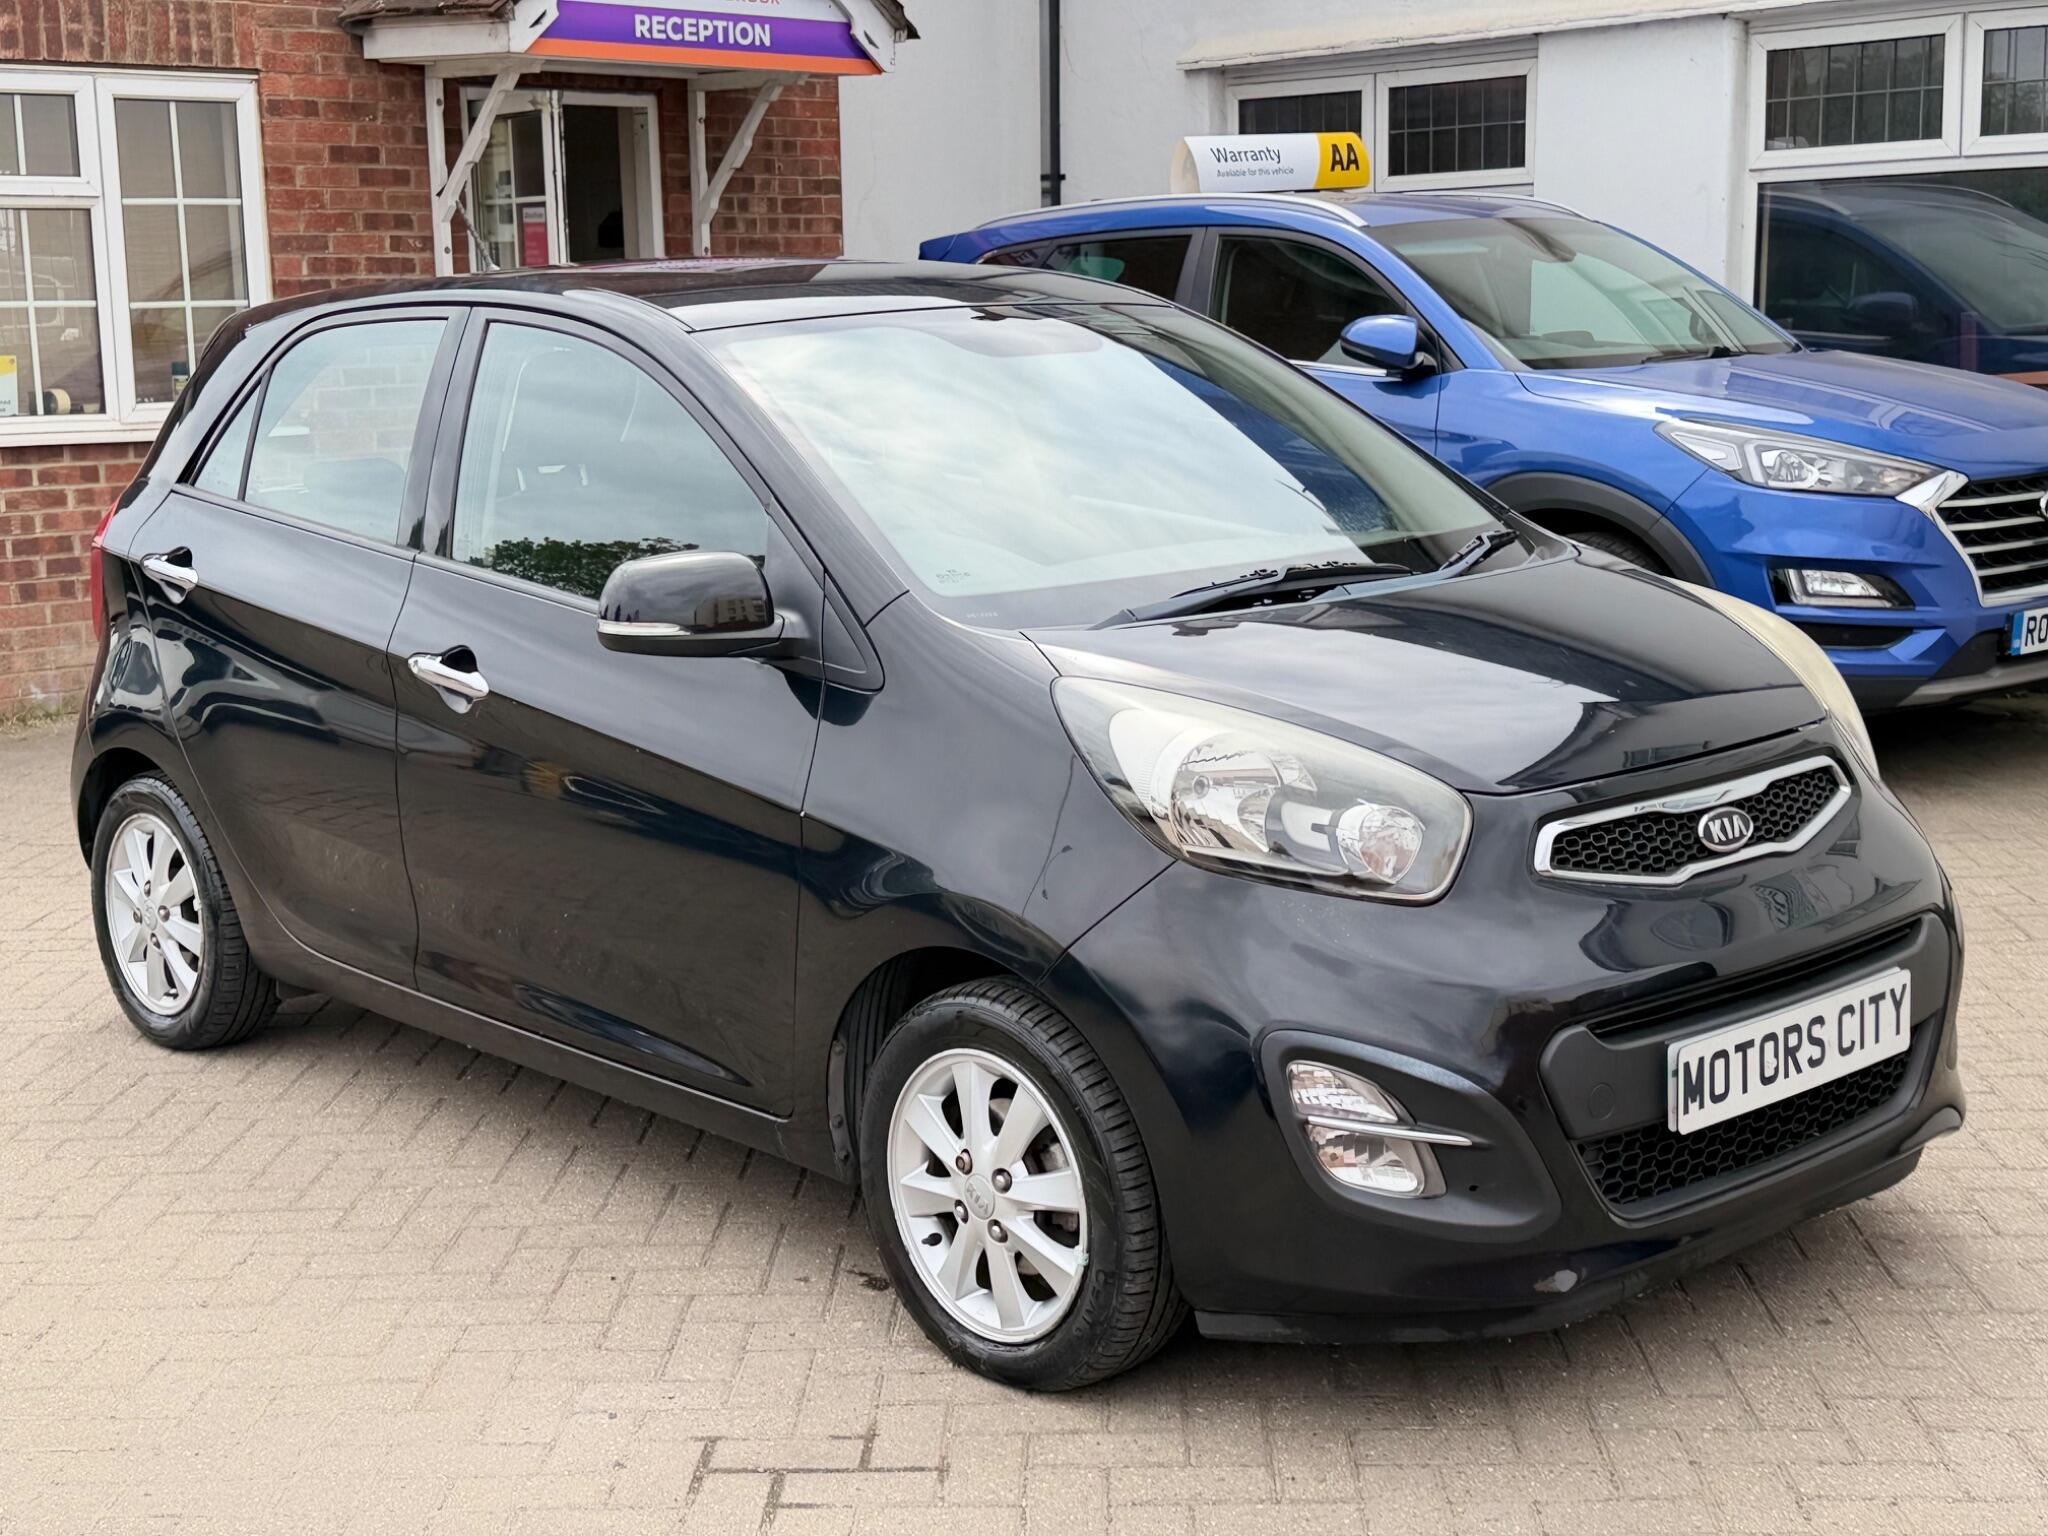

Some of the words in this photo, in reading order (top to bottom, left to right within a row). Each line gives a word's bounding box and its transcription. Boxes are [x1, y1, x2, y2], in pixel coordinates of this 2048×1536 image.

[634, 14, 771, 46] RECEPTION
[1210, 146, 1281, 164] Warranty
[1330, 143, 1360, 172] AA
[1247, 168, 1257, 176] for
[1258, 167, 1271, 176] this
[1272, 166, 1294, 175] vehicle
[2025, 614, 2048, 647] RO
[1708, 814, 1748, 843] KIA
[1682, 1015, 1826, 1115] MOTORS
[1837, 983, 1907, 1057] CITY
